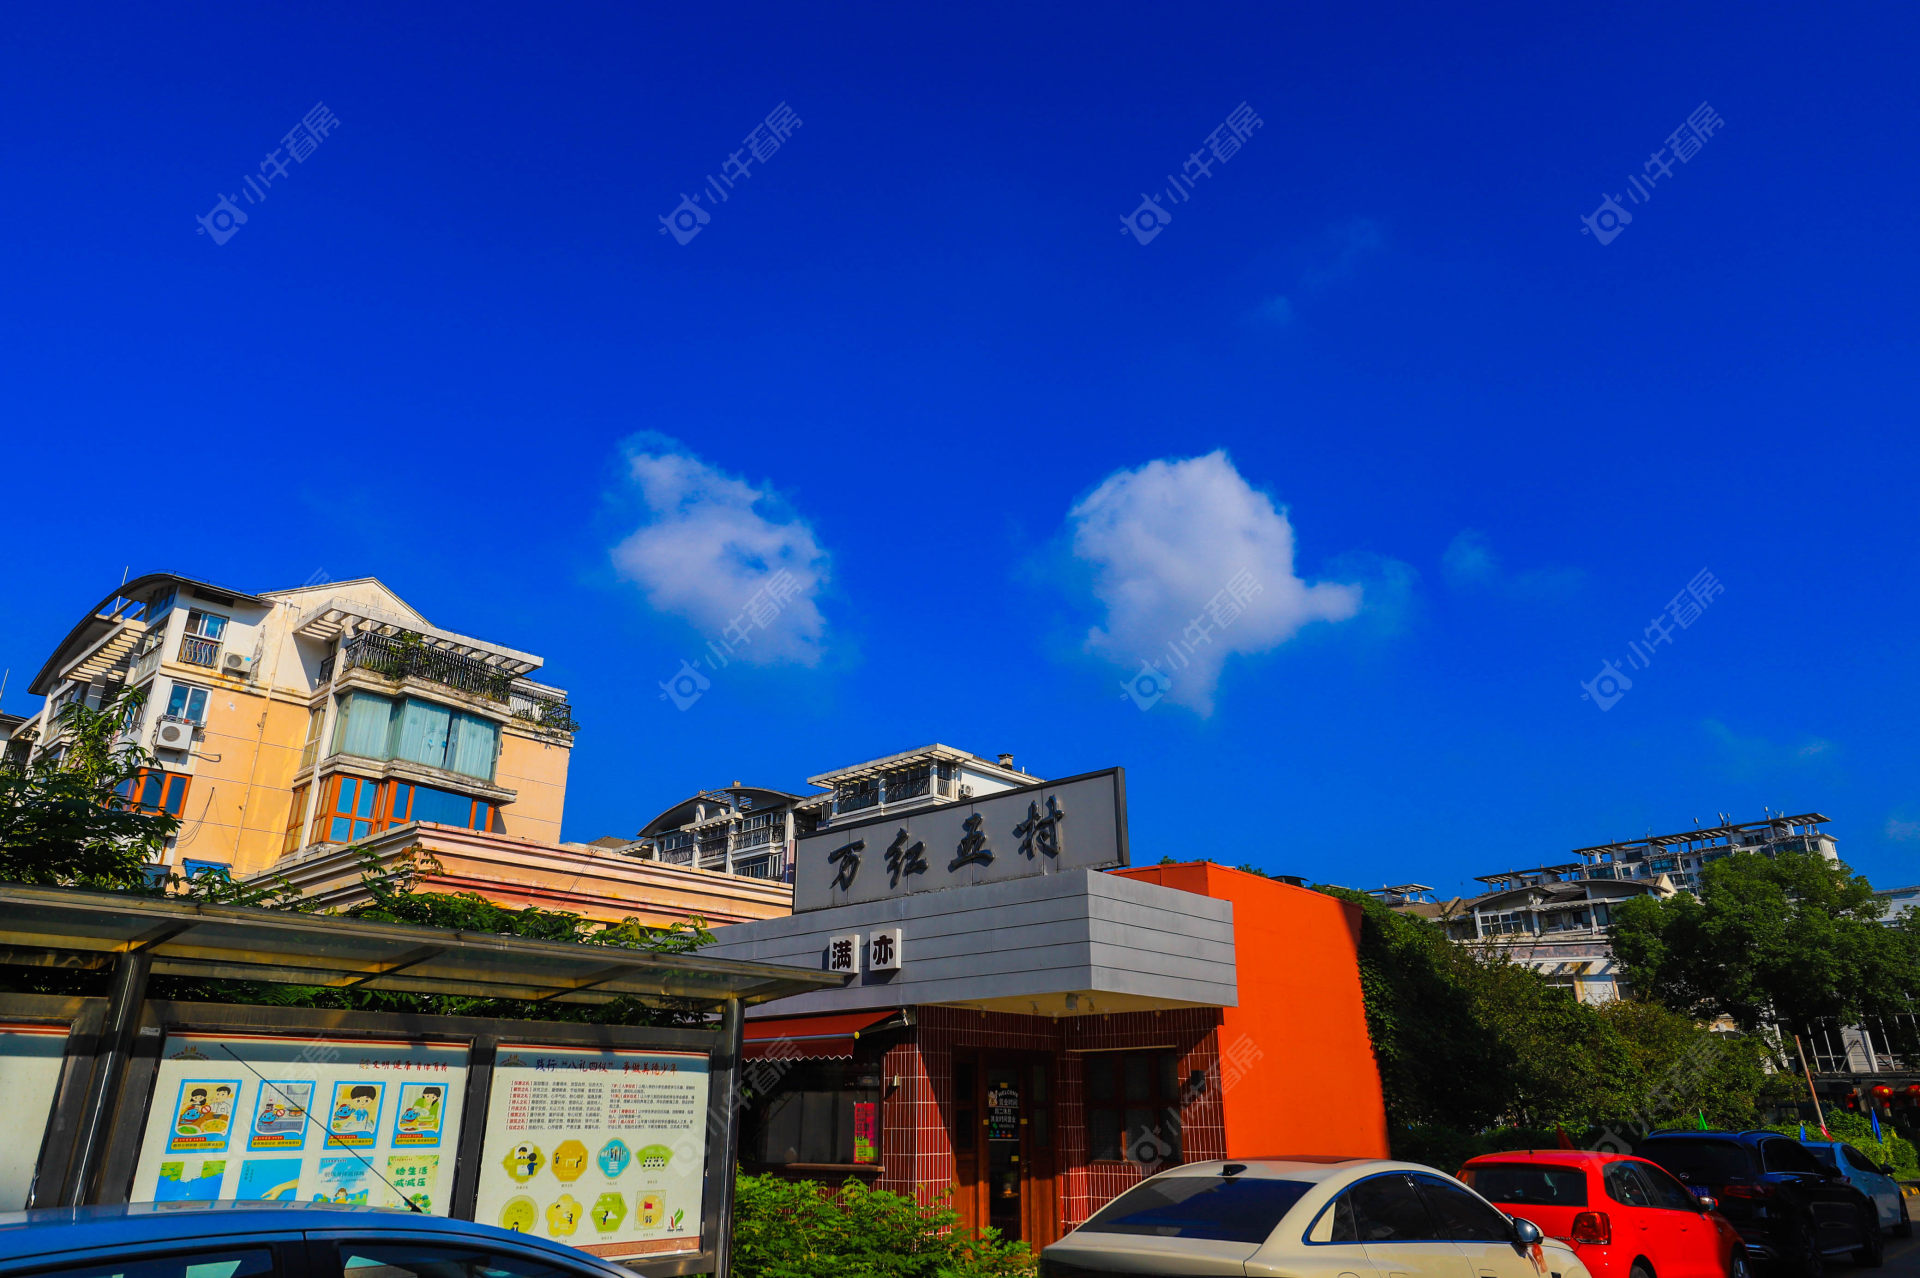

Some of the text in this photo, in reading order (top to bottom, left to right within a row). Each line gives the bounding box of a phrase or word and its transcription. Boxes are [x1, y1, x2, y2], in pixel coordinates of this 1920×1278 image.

[829, 795, 1065, 890] 万红五村
[393, 1178, 426, 1188] 减减压
